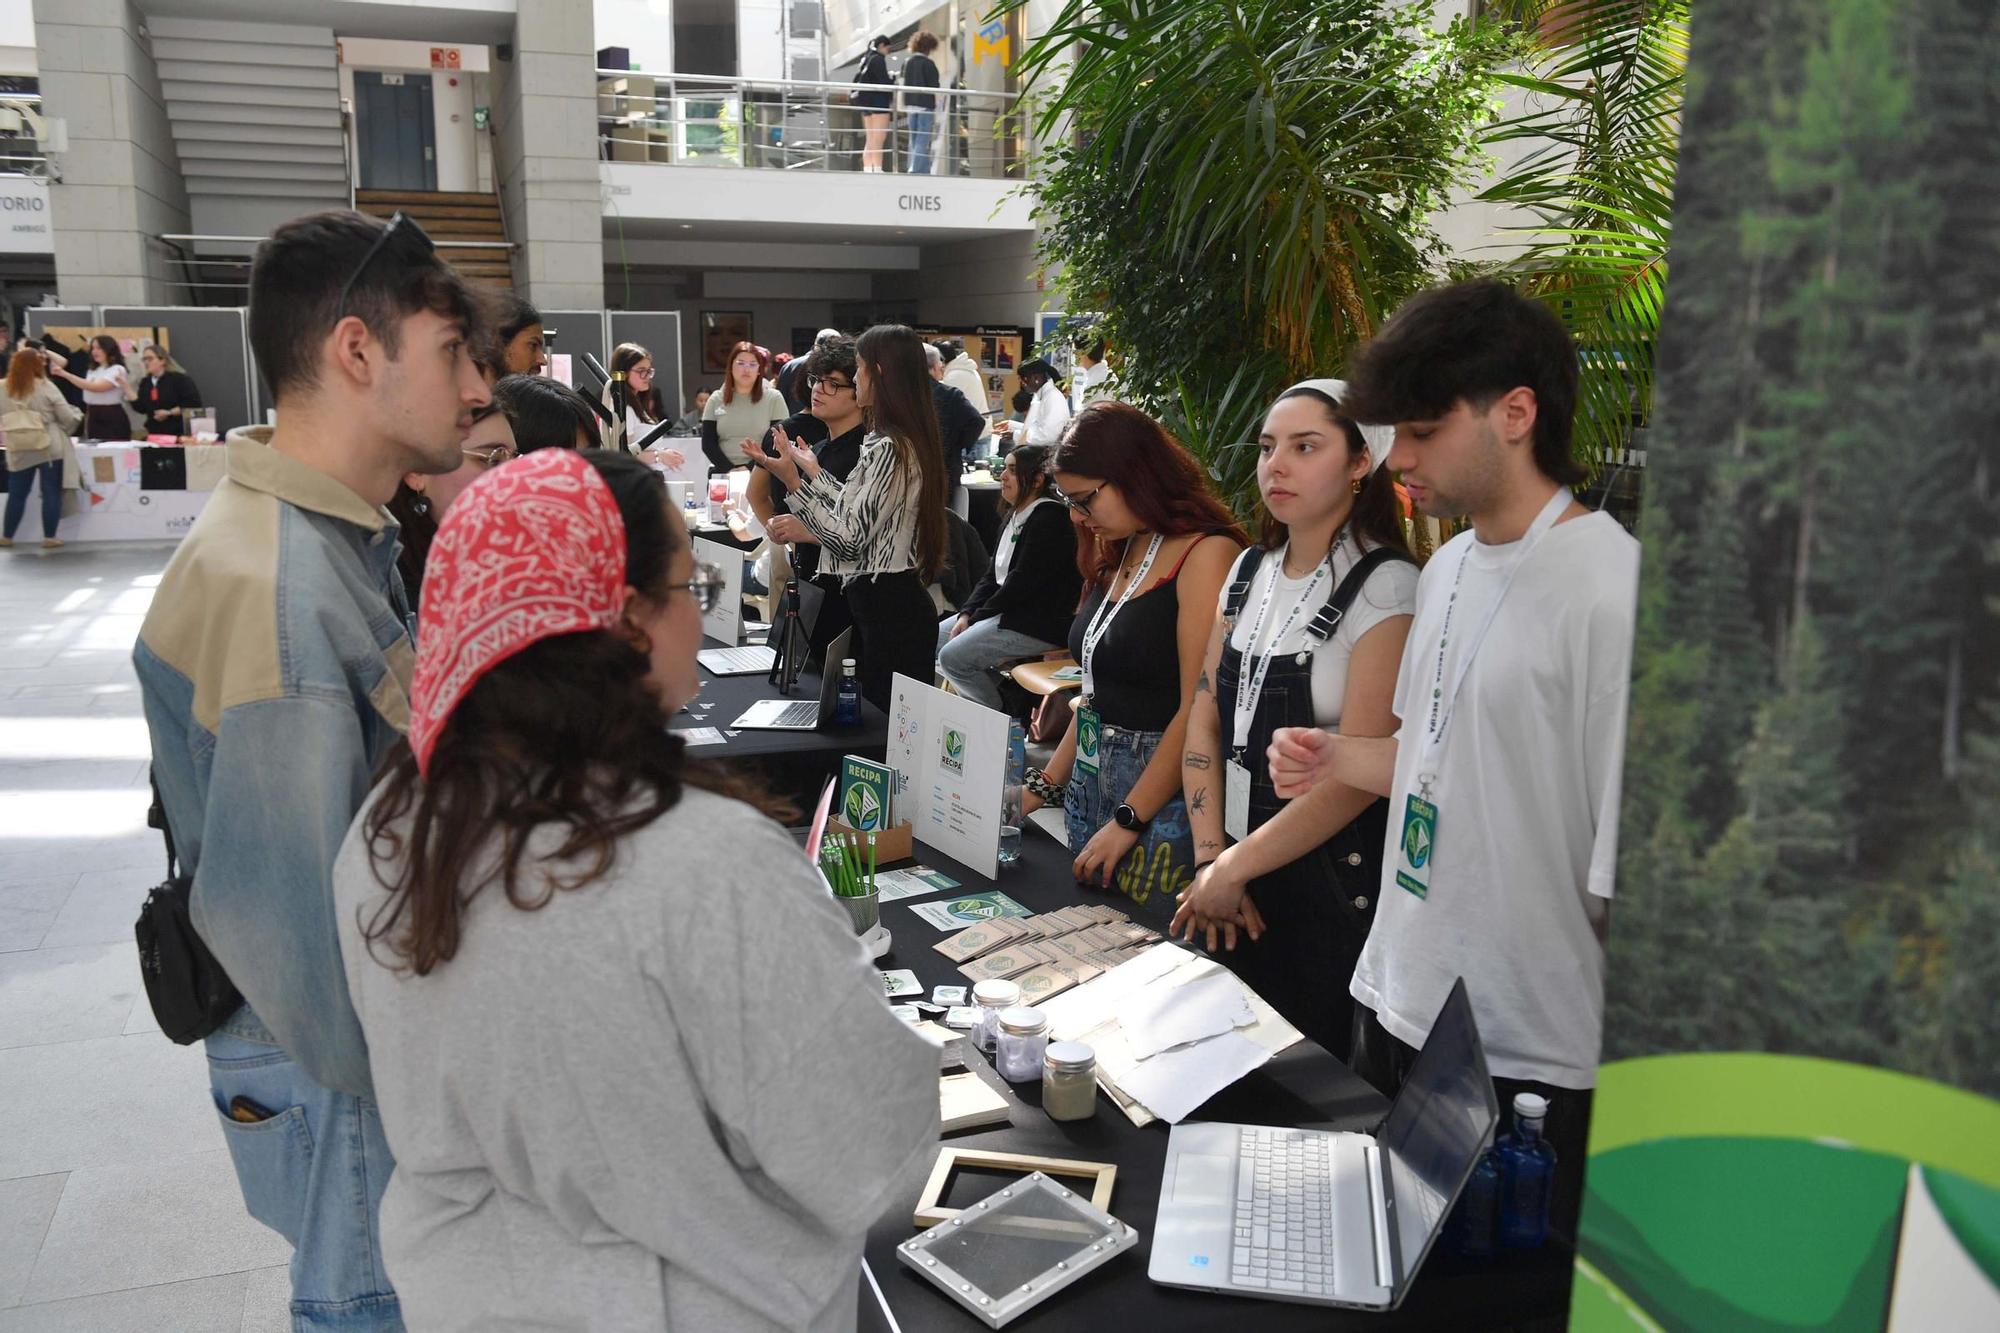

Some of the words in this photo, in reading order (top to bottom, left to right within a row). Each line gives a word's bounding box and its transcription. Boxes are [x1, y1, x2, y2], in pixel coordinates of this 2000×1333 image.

[0, 196, 45, 211] ORIO
[898, 194, 942, 211] CINES
[1300, 578, 1318, 602] RECIPA
[1257, 649, 1272, 673] RECIPA
[1237, 682, 1245, 708] RECIPA
[1245, 687, 1257, 712] RECIPA
[1429, 701, 1440, 734] RECIPA
[848, 764, 882, 785] RECIPA
[941, 755, 963, 771] RECIPA
